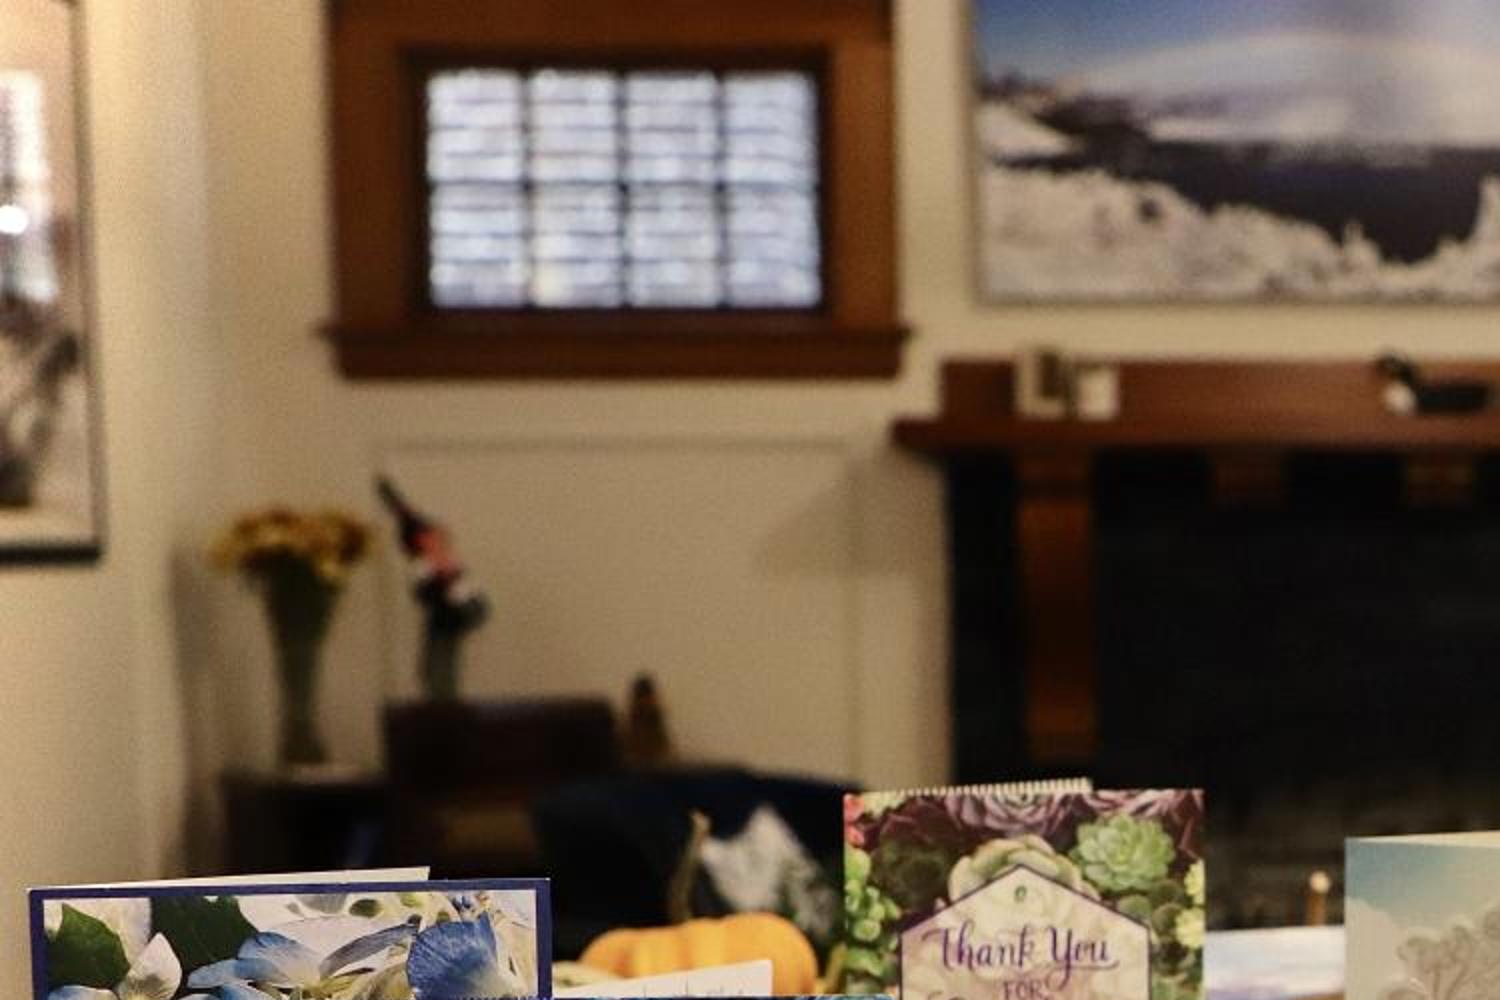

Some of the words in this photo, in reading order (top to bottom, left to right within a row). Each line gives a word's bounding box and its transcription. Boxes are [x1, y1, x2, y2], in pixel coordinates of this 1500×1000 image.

[921, 919, 1036, 974] Thank
[1045, 924, 1121, 991] You
[1002, 980, 1046, 1000] FOR
